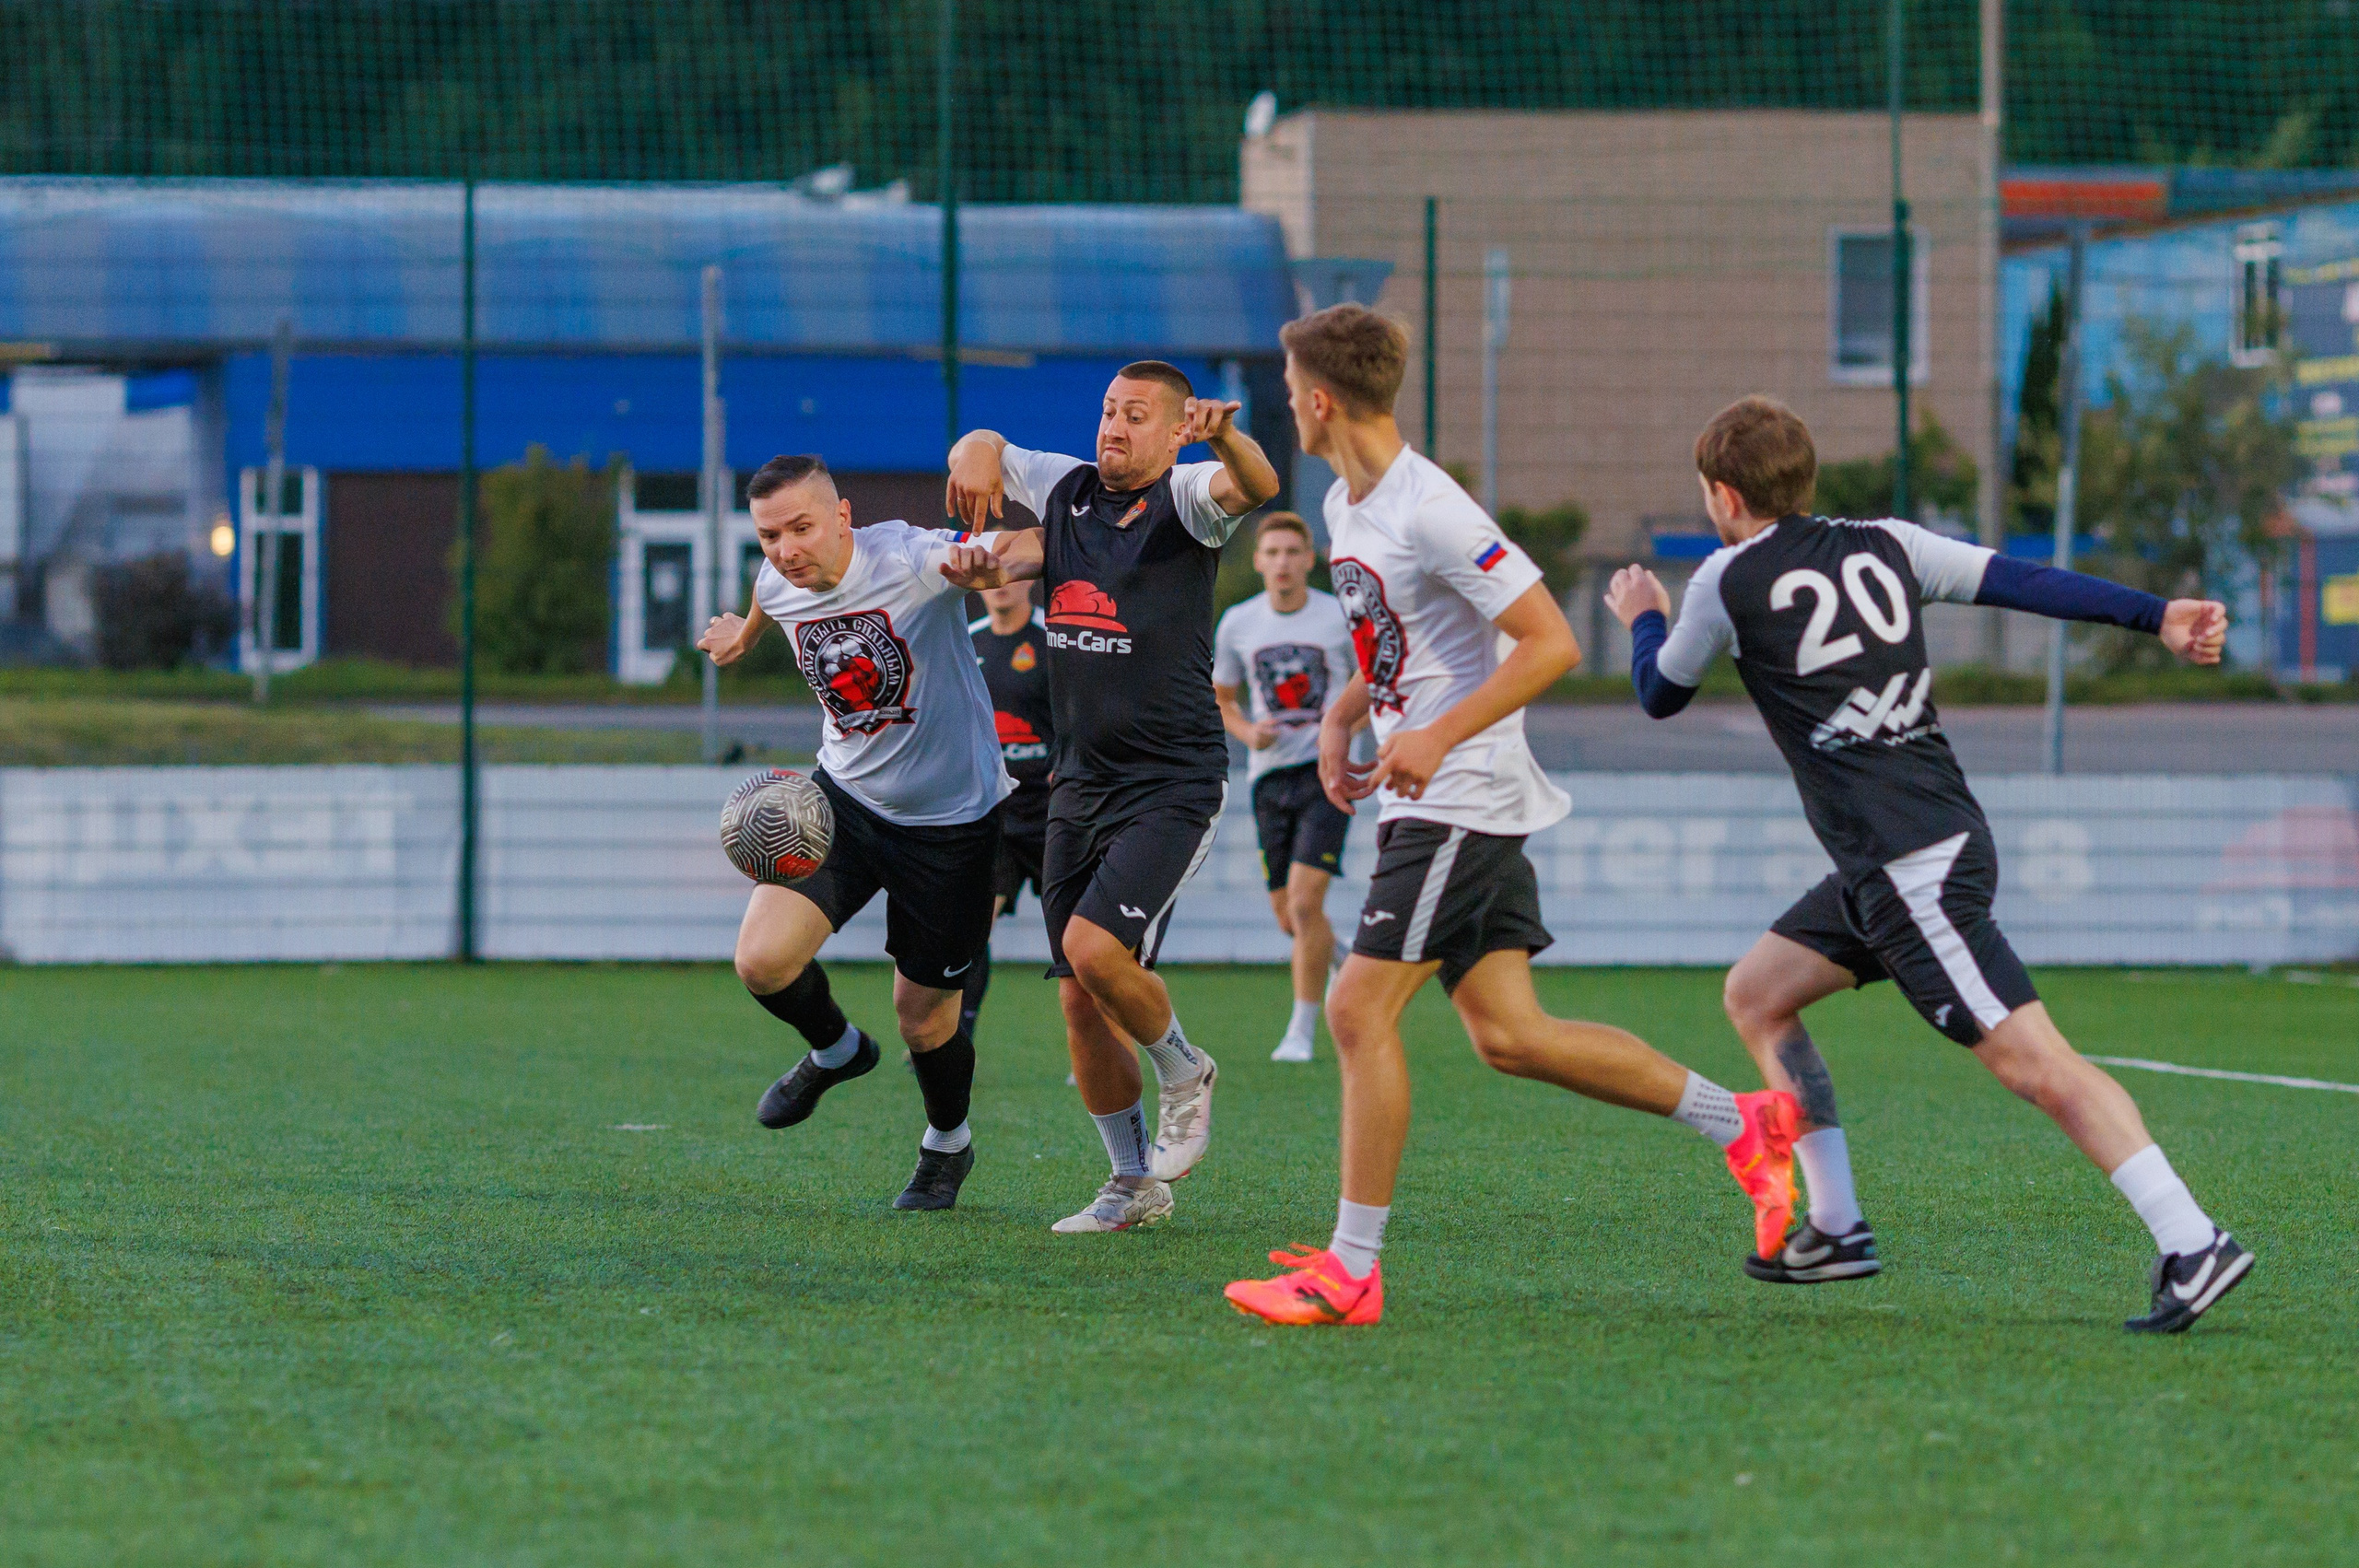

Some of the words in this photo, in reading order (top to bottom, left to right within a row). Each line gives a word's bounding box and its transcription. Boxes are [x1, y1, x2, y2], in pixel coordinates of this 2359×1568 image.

[1047, 630, 1133, 654] me-Cars
[1770, 552, 1910, 676] 20
[811, 618, 847, 645] БЫТЬ
[852, 619, 900, 685] СИЛЬНЫМ
